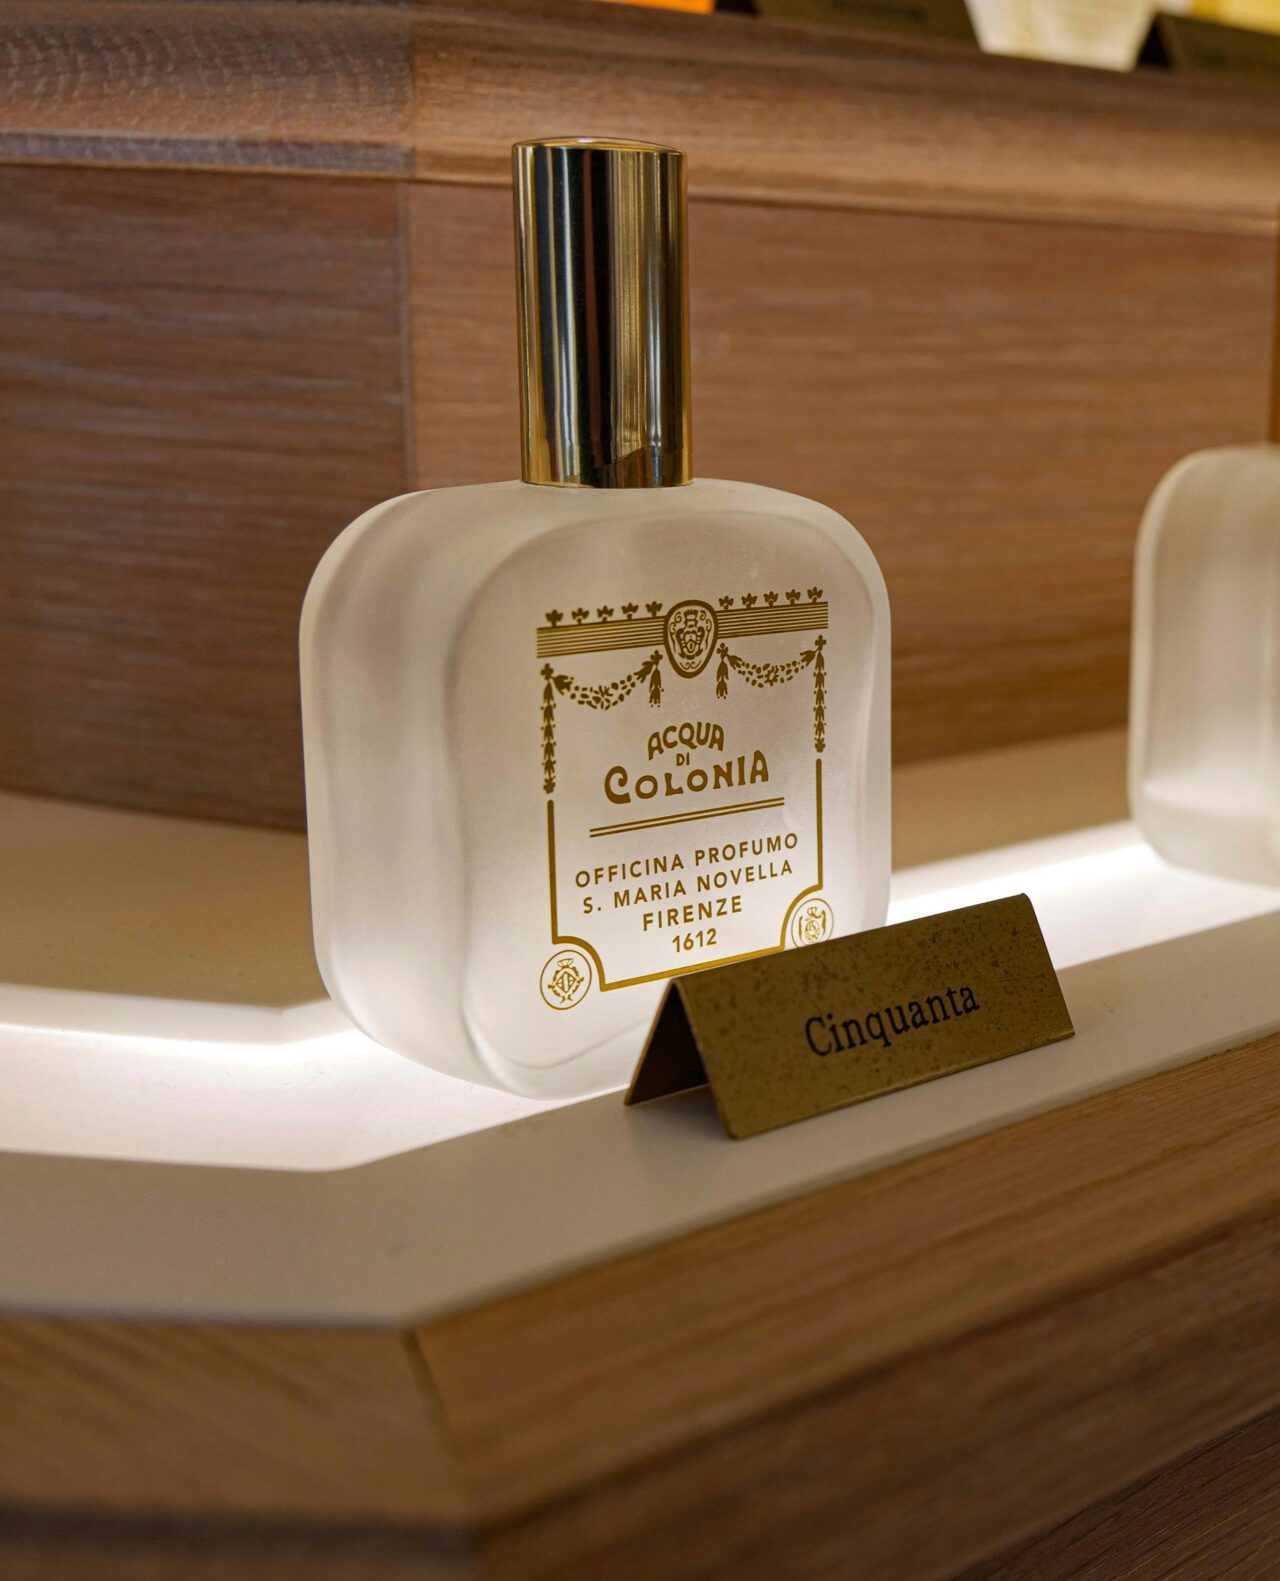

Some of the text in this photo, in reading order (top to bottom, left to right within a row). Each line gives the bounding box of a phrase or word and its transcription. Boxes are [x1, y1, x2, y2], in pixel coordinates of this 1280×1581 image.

[648, 722, 724, 760] ACQUA
[676, 753, 690, 766] DI
[604, 761, 769, 804] COLONIA
[575, 833, 798, 888] OFFICINA PROFUMO
[583, 860, 792, 914] S. MARIA NOVELLA
[643, 895, 743, 931] FIRENZE
[672, 928, 718, 952] 1612
[805, 984, 981, 1057] Cinquanta
